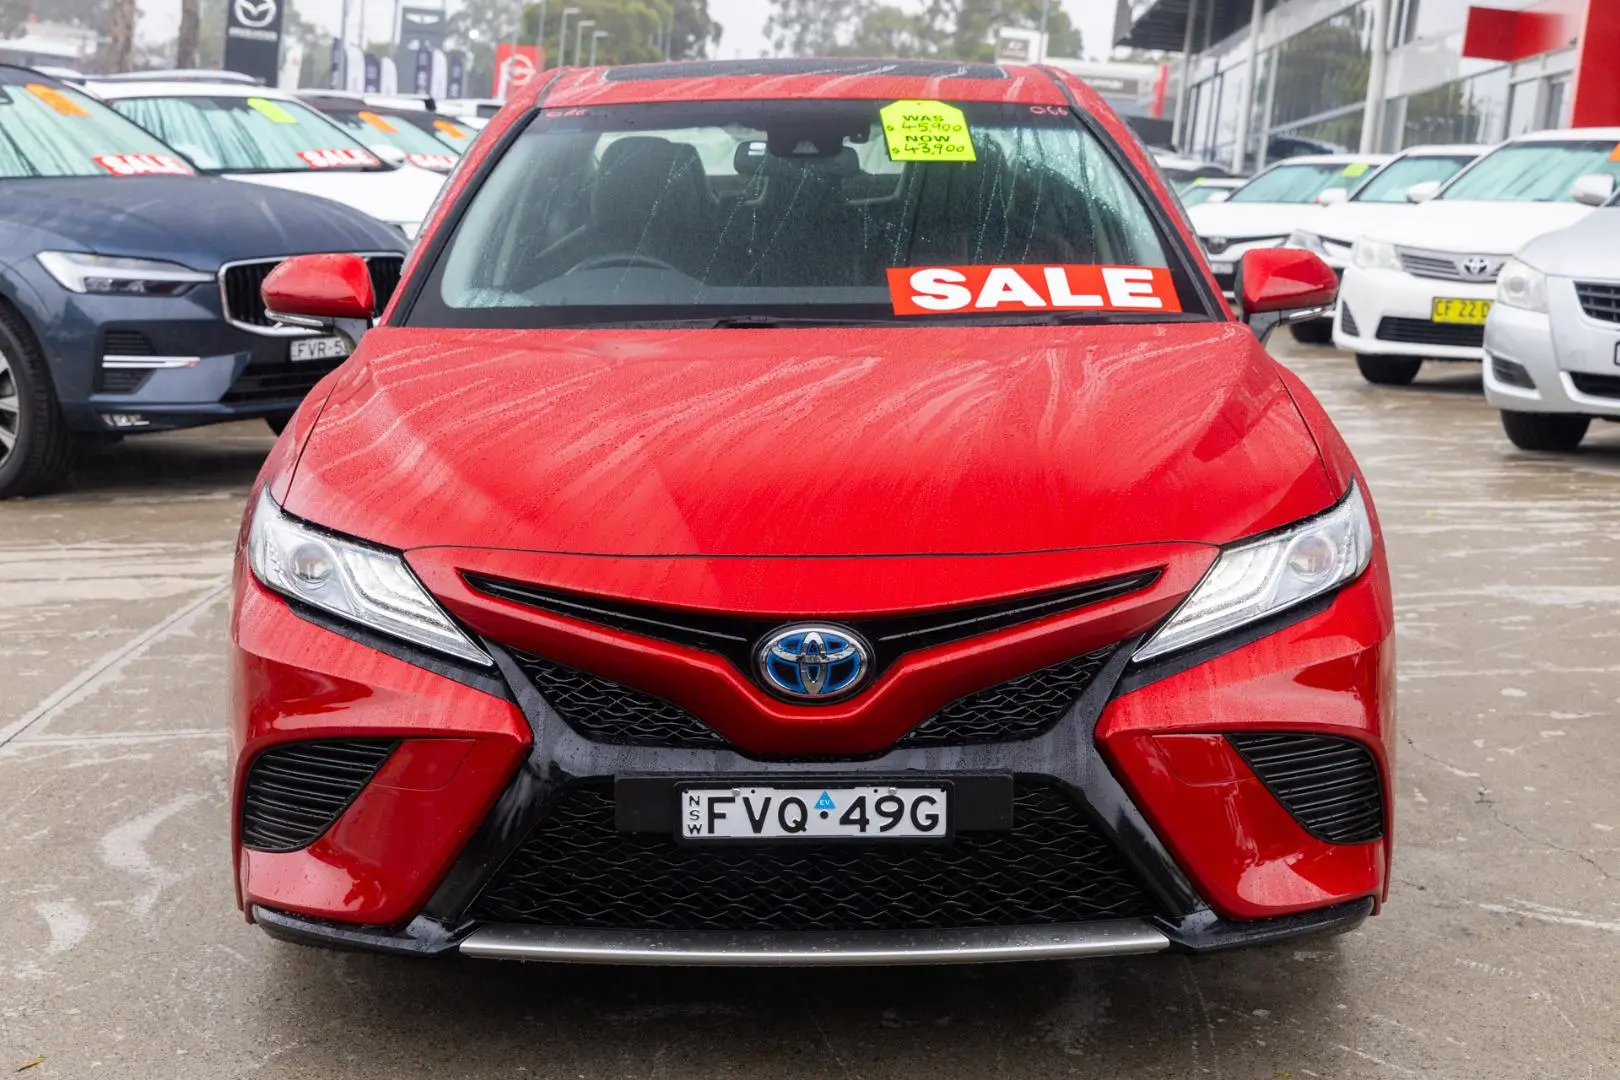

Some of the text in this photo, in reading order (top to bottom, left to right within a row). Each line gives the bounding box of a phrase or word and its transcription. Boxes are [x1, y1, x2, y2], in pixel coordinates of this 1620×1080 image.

[902, 114, 944, 122] WAS
[102, 155, 194, 175] SALE
[909, 267, 1163, 310] SALE
[818, 799, 831, 807] EV
